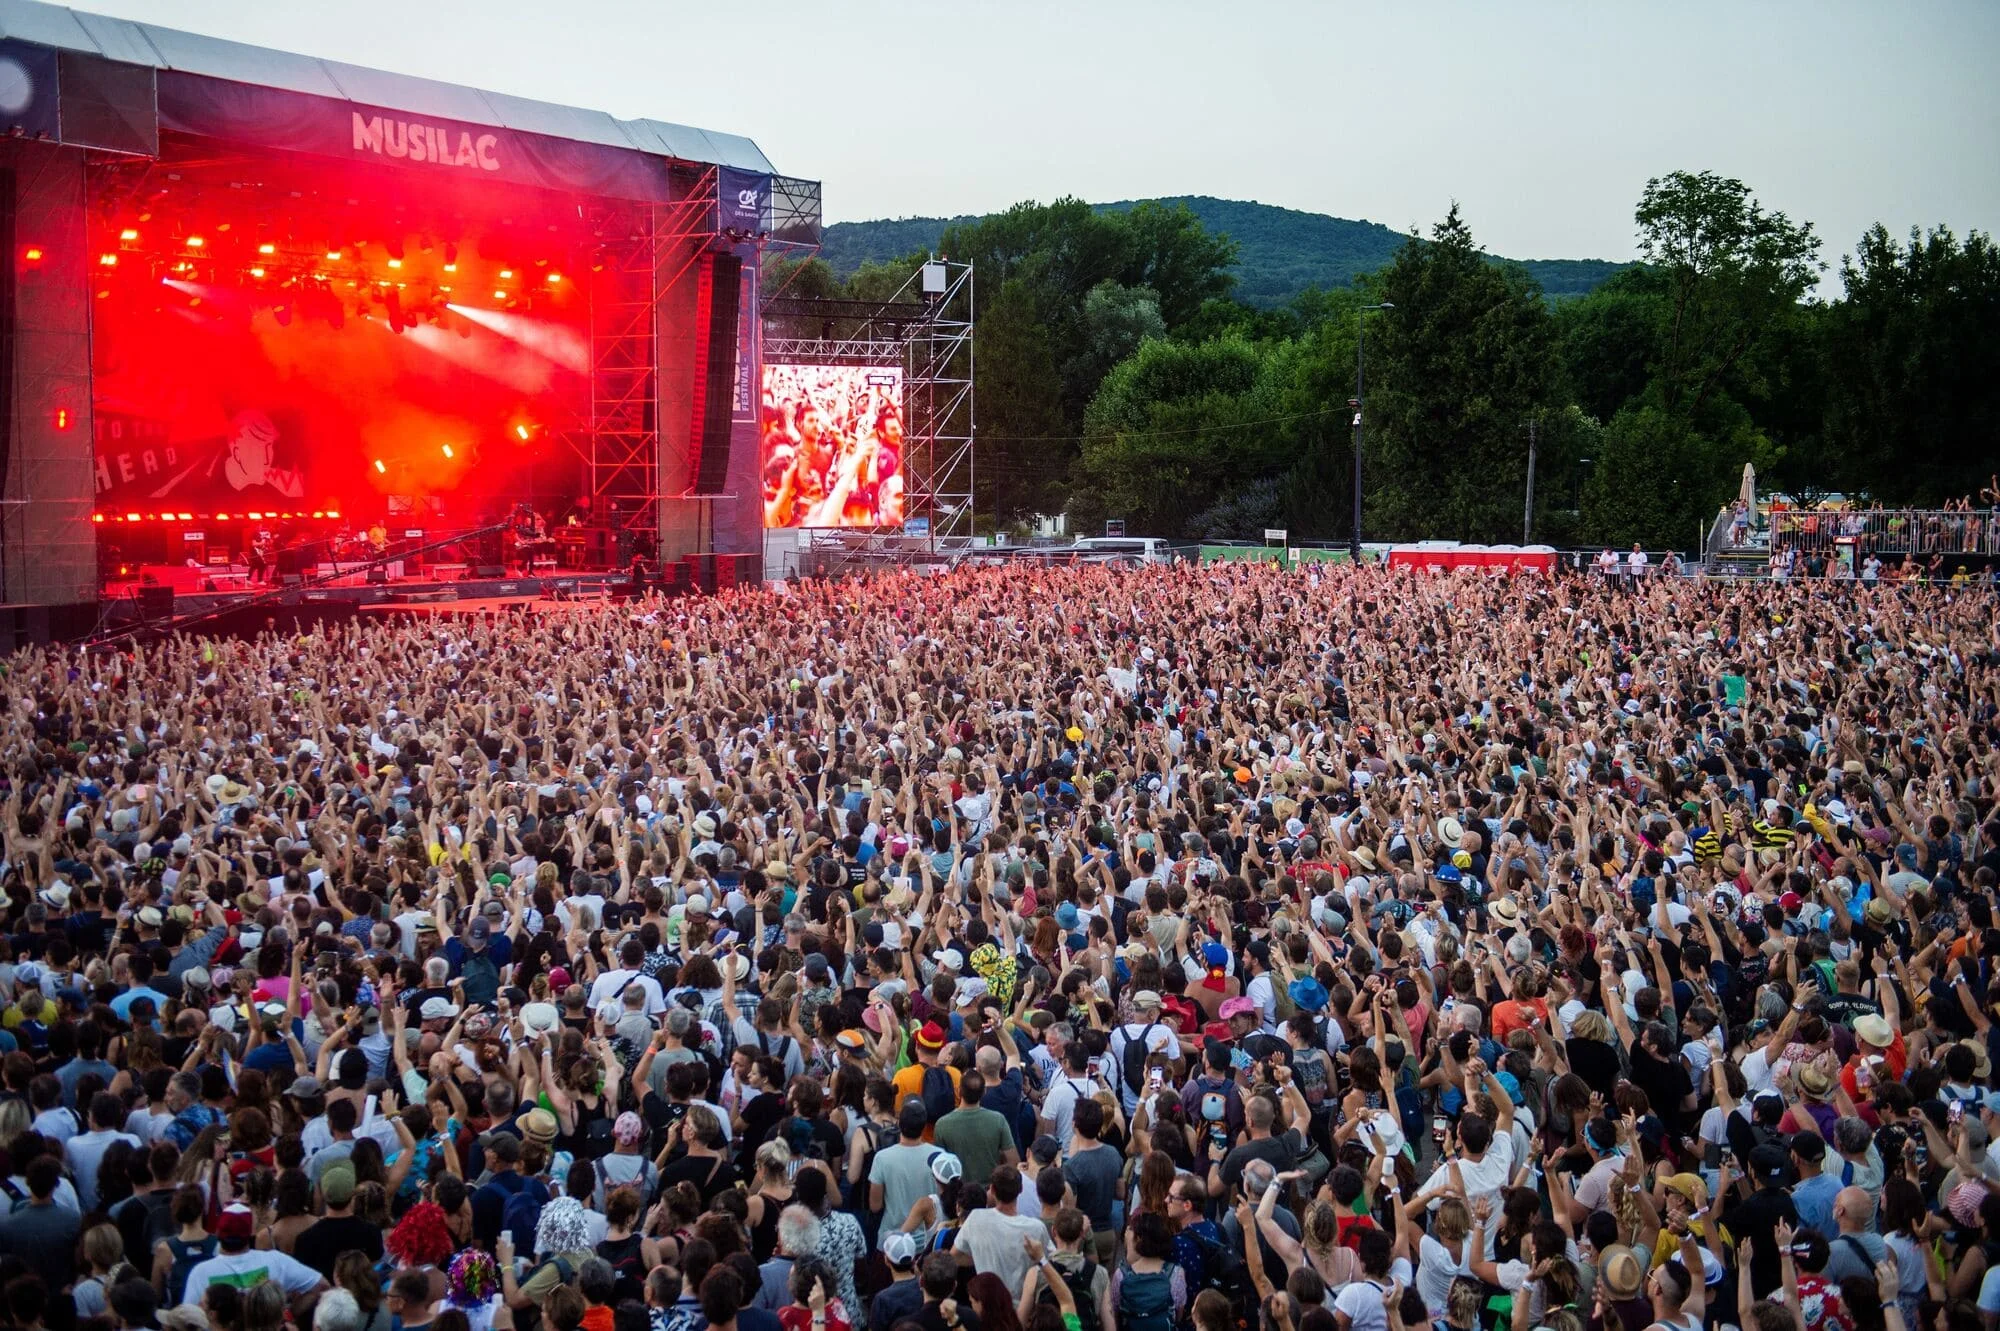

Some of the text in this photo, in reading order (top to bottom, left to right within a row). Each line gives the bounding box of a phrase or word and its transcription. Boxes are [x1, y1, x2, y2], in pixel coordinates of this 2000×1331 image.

[352, 111, 500, 171] MUSILAC
[741, 364, 749, 412] FESTIVAL
[94, 418, 122, 440] TO
[95, 446, 177, 494] HEAD
